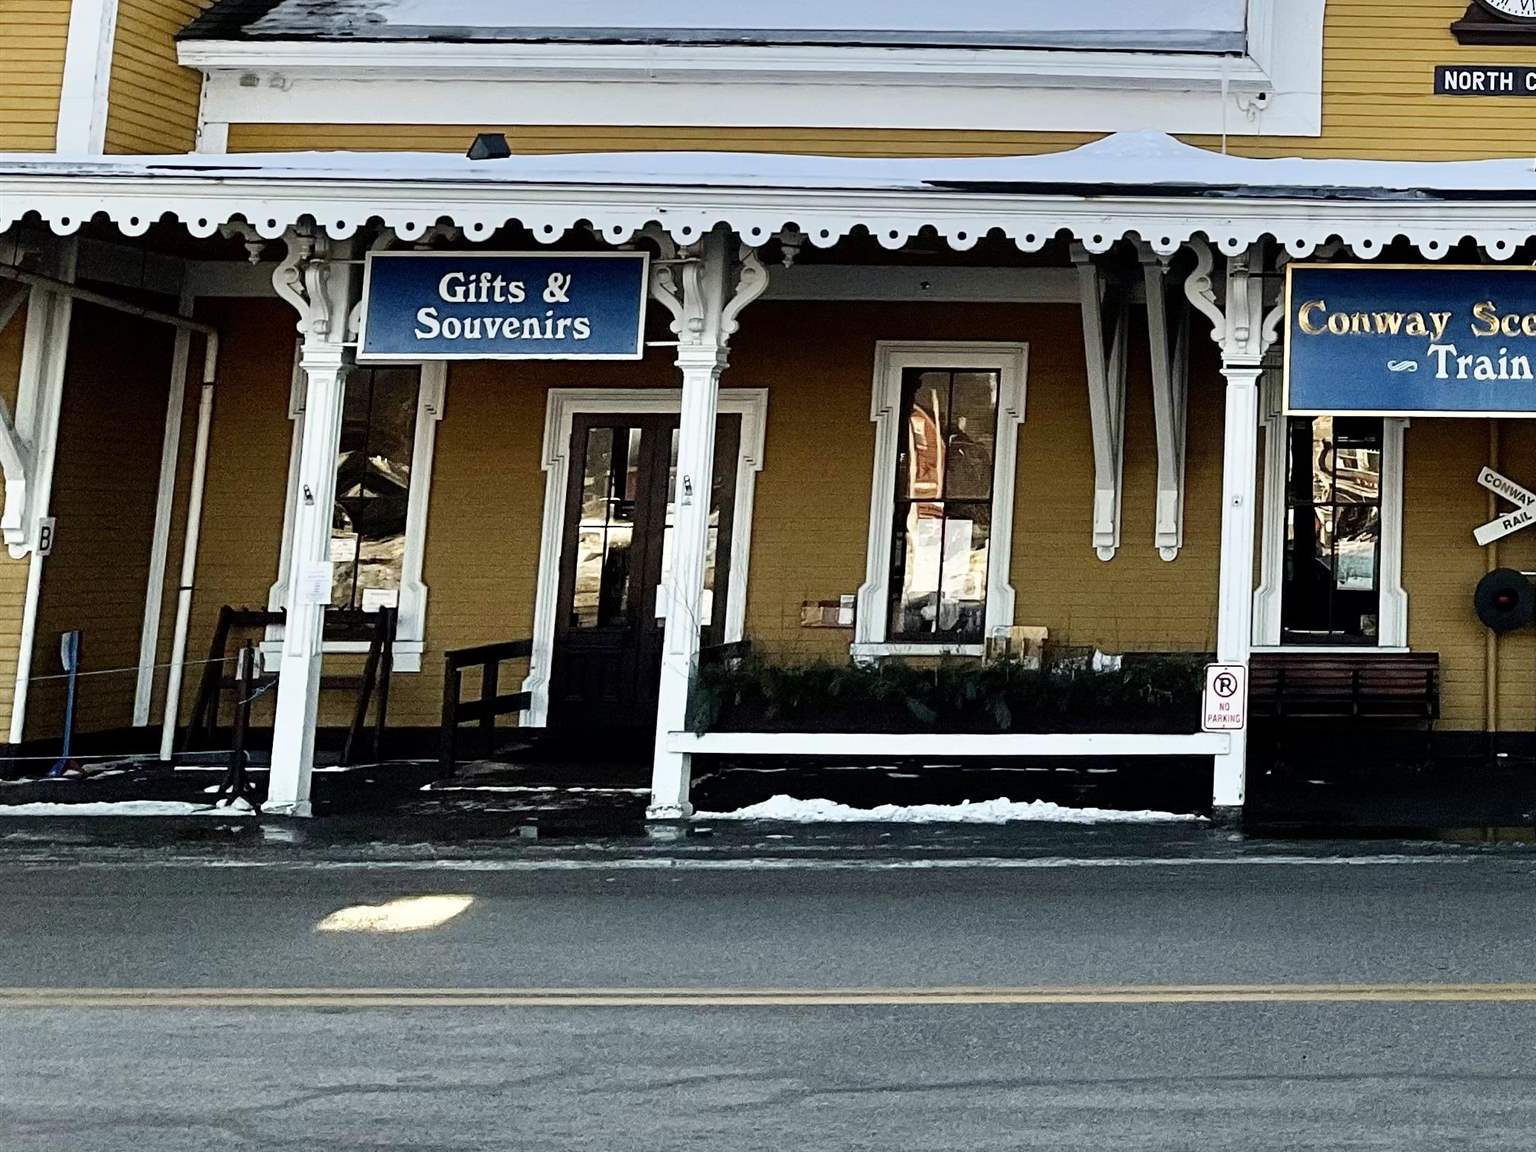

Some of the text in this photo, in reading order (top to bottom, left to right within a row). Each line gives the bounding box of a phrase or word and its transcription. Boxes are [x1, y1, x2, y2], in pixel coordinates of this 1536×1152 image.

[1444, 70, 1513, 91] NORTH
[438, 272, 572, 304] Gifts &
[414, 307, 591, 340] Souvenirs
[1298, 299, 1451, 341] Conway
[1427, 343, 1534, 381] Train
[1484, 473, 1535, 506] CONWAY
[1503, 511, 1533, 530] RAIL
[40, 526, 51, 550] B
[1207, 714, 1241, 723] PARKING
[1219, 702, 1231, 711] NO
